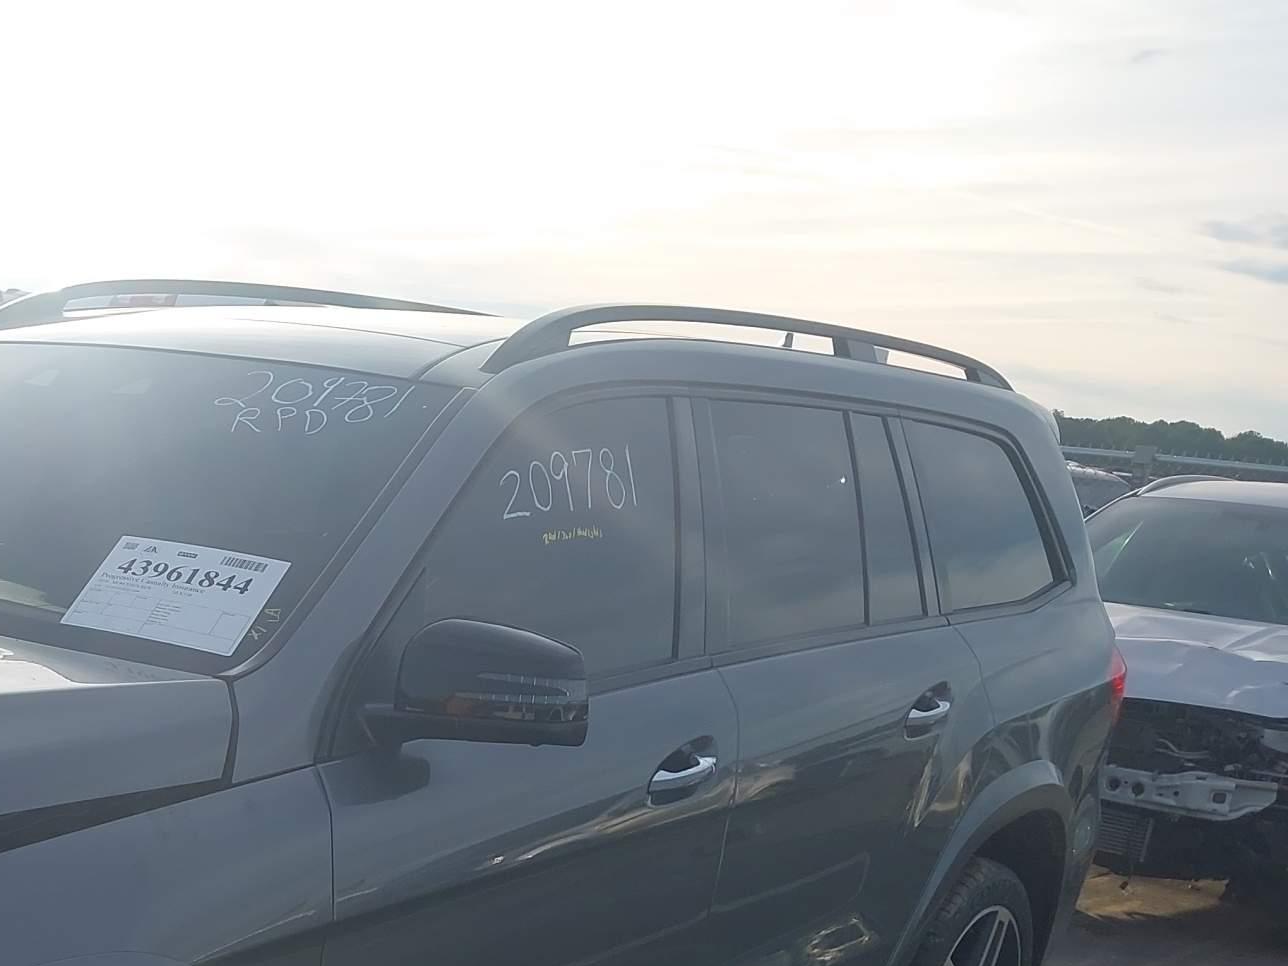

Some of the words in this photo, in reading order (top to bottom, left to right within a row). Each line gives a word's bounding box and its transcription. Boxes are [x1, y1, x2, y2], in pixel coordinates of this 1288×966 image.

[214, 370, 416, 423] 209781
[499, 444, 638, 520] 209781
[116, 557, 254, 595] 43961844
[171, 582, 206, 594] Insurance
